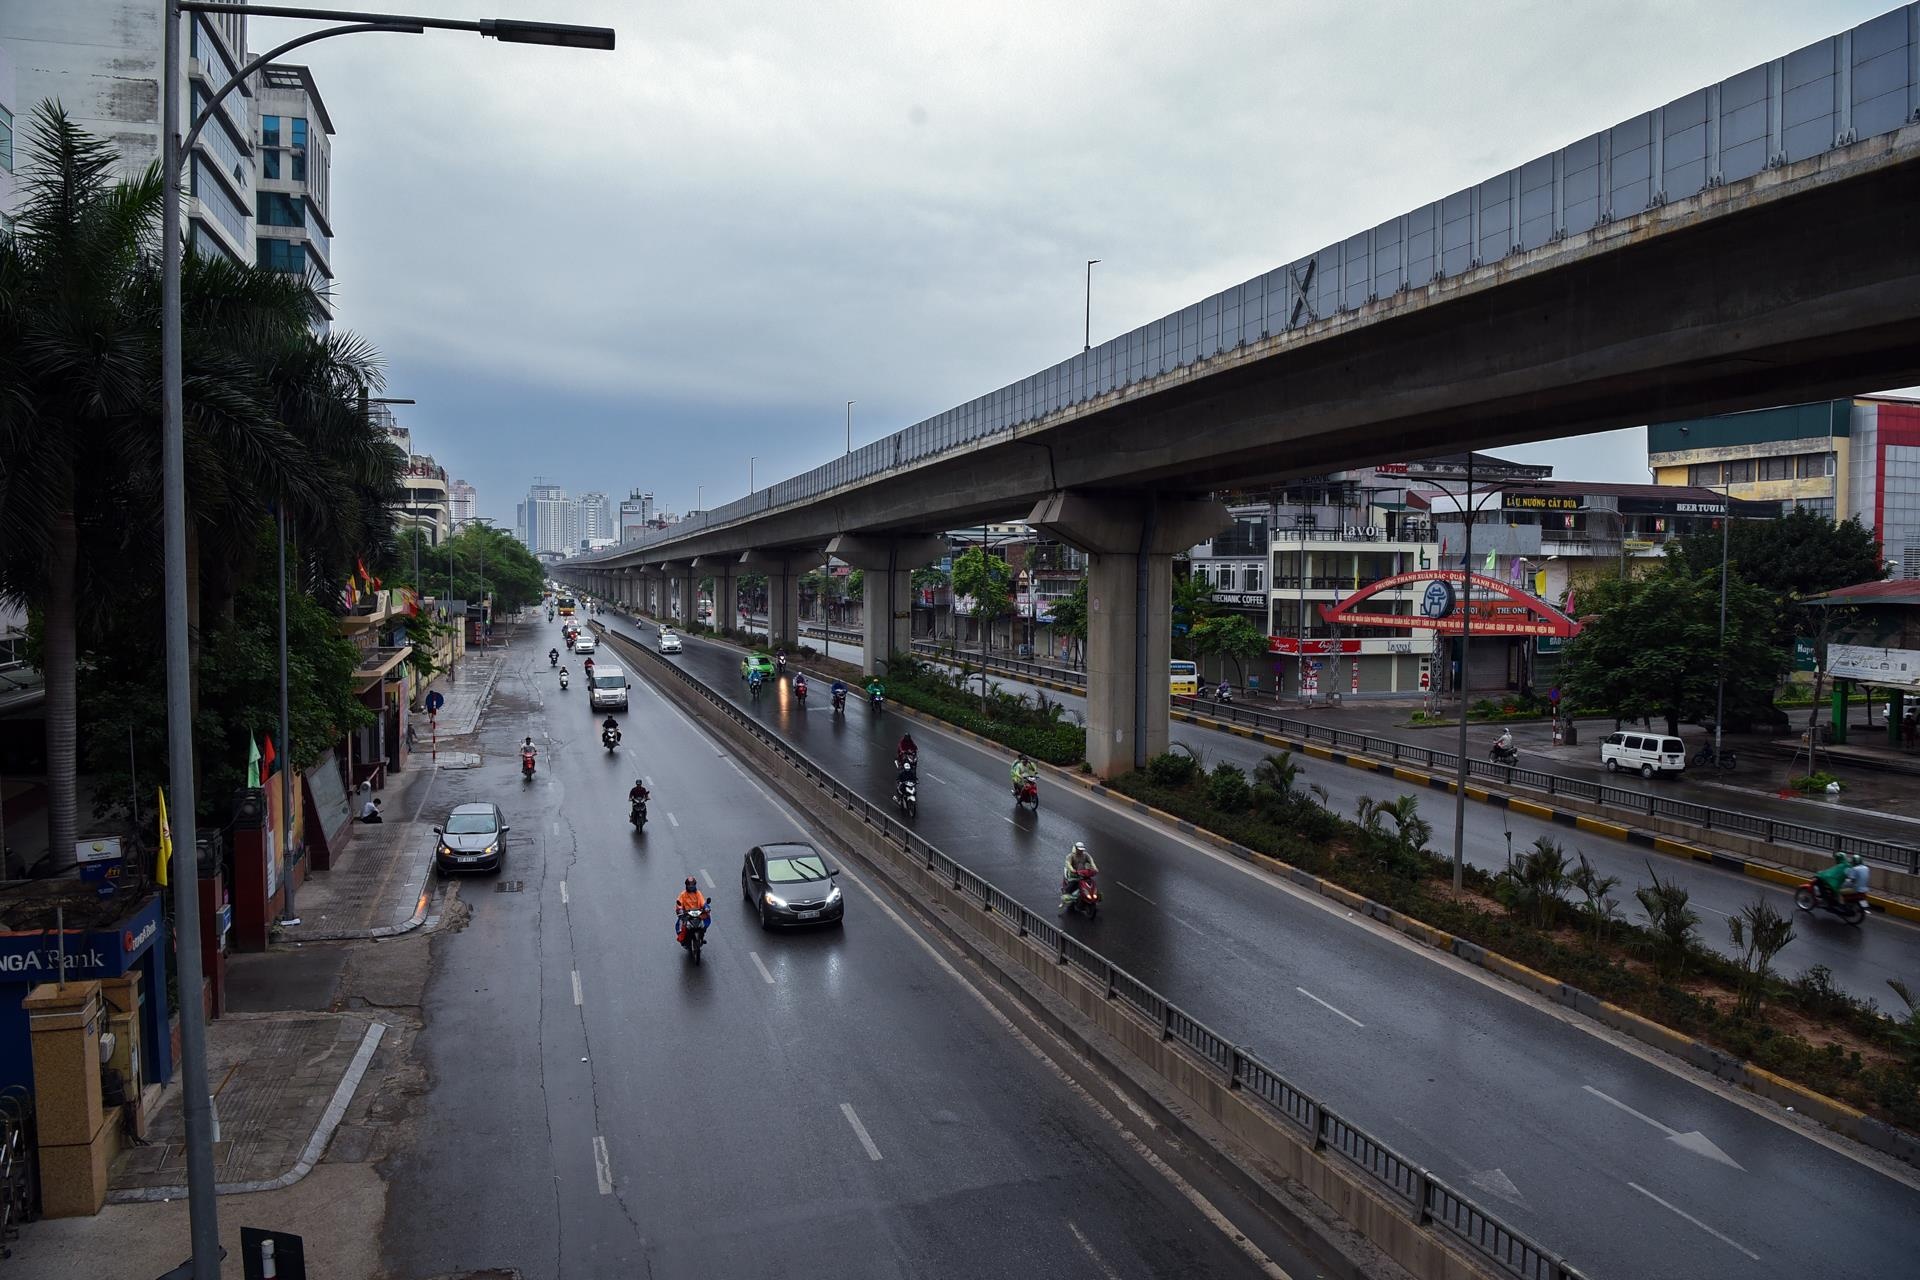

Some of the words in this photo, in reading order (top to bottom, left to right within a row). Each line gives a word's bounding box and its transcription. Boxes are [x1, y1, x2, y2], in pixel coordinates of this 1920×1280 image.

[1676, 503, 1698, 512] BEER
[1211, 594, 1241, 604] MECHANIC
[1242, 595, 1264, 605] COFFEE
[1497, 607, 1511, 615] THE
[1512, 607, 1528, 615] ONE
[47, 948, 105, 970] Bank
